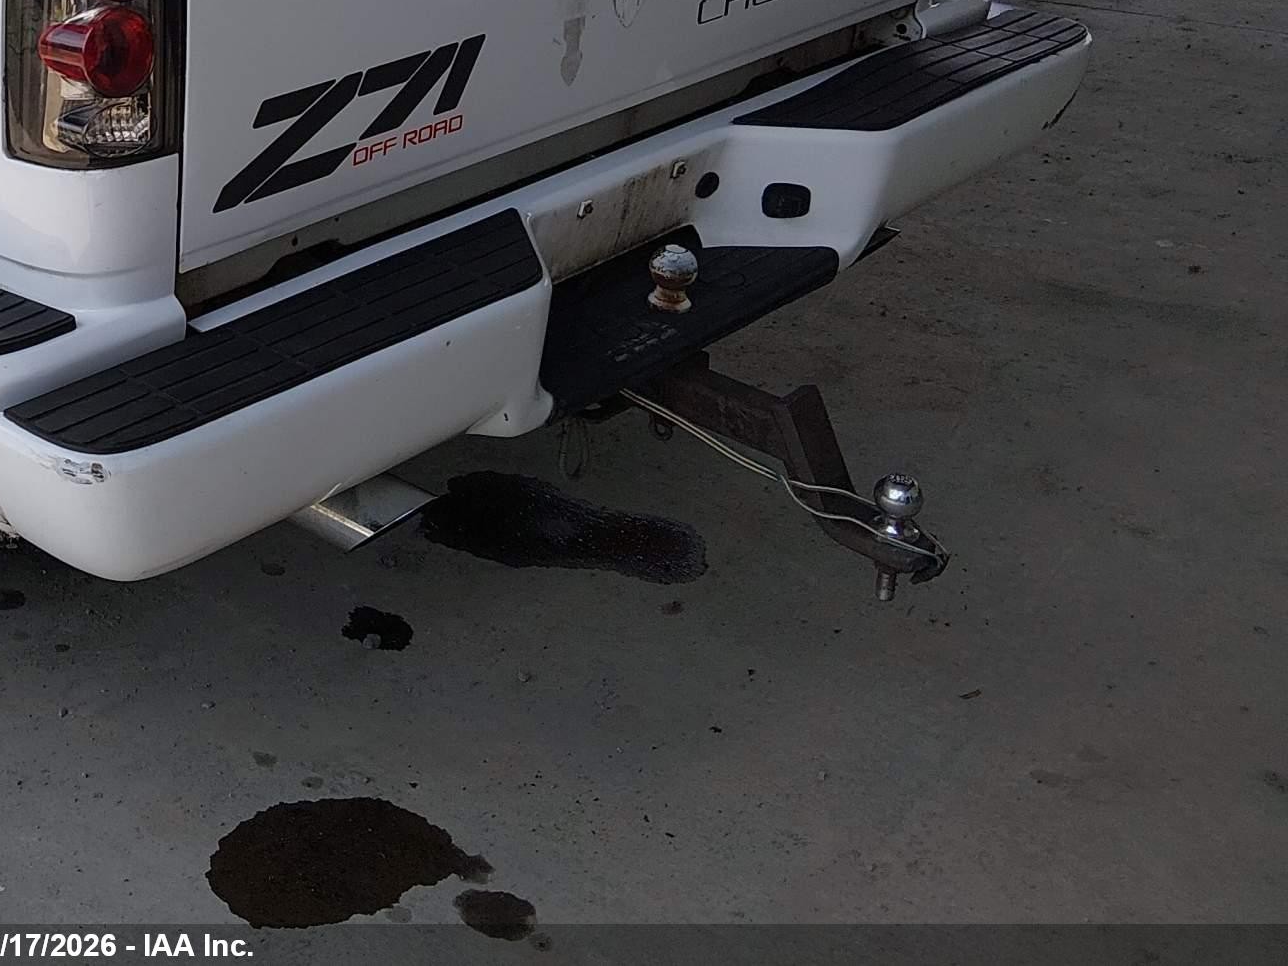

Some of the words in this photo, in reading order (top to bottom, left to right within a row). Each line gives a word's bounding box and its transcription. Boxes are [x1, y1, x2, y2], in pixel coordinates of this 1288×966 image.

[212, 33, 486, 214] Z71
[352, 137, 398, 167] OFF
[402, 114, 464, 150] ROAD
